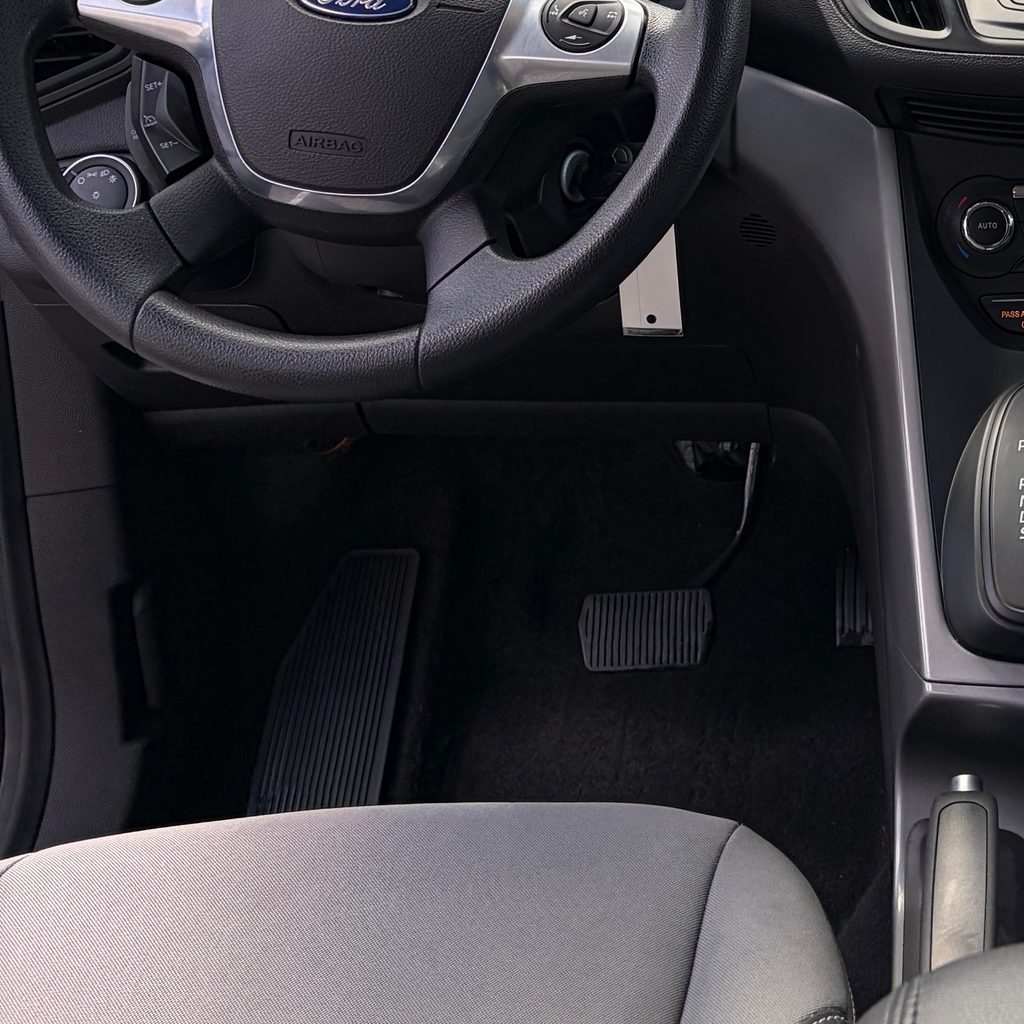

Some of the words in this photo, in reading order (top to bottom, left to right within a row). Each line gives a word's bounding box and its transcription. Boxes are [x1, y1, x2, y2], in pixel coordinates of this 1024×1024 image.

[295, 135, 364, 153] AIRBAG
[977, 222, 998, 230] AUTO
[1001, 310, 1020, 318] PASS
